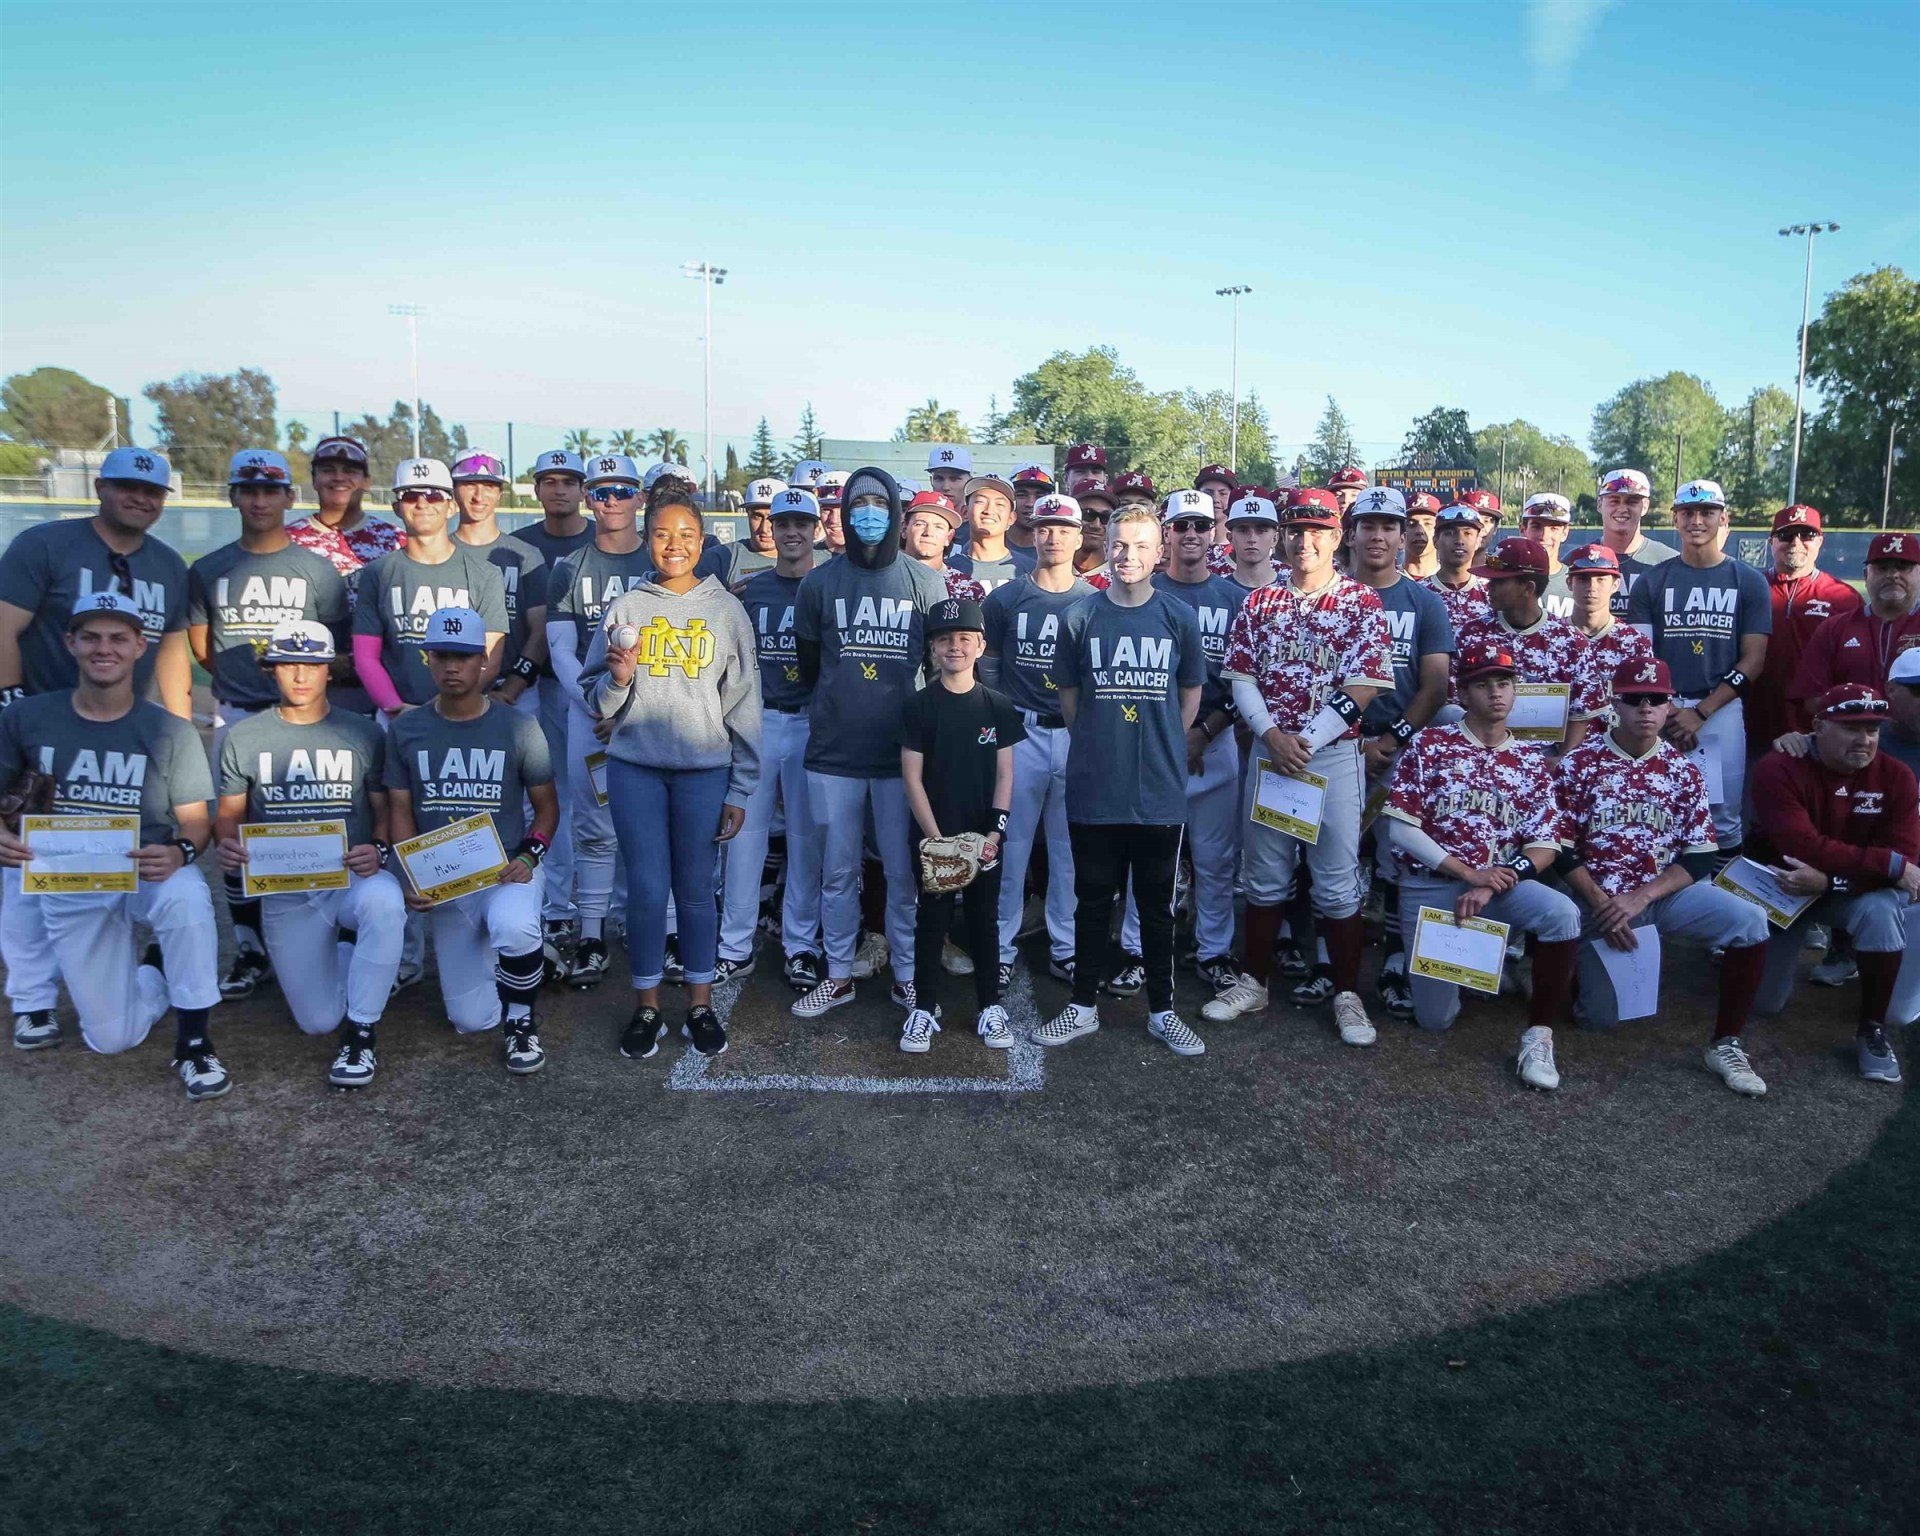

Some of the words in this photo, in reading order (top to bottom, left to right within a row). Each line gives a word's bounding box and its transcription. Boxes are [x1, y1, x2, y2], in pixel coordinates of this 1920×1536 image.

[1407, 470, 1433, 478] DAME
[1435, 470, 1475, 478] KNIGHTS
[217, 578, 229, 606] I
[240, 576, 307, 608] AM
[391, 586, 404, 615] I
[410, 585, 470, 615] AM
[582, 577, 593, 604] I
[602, 576, 641, 602] A
[1664, 588, 1674, 612] I
[1684, 587, 1738, 613] AM
[220, 607, 241, 622] VS.
[243, 606, 303, 623] CANCER
[835, 598, 848, 629] I
[853, 596, 913, 630] AM
[1547, 595, 1575, 619] M
[759, 607, 769, 634] I
[778, 606, 795, 632] A
[1017, 613, 1028, 639] I
[1038, 614, 1059, 641] A
[1199, 606, 1228, 635] M
[1387, 611, 1416, 639] M
[1664, 614, 1684, 627] VS.
[1686, 613, 1733, 628] CANCER
[760, 635, 777, 649] VS.
[855, 629, 909, 647] CANCER
[1017, 641, 1036, 656] VS.
[1202, 636, 1224, 651] CER
[1090, 637, 1102, 668] I
[1112, 636, 1172, 669] AM
[1115, 670, 1169, 688] CANCER
[66, 748, 147, 787] AM
[259, 752, 273, 784] I
[285, 749, 353, 782] AM
[418, 750, 431, 781] I
[439, 748, 506, 781] AM
[54, 784, 65, 799] S.
[68, 785, 141, 805] CANCER
[262, 786, 286, 801] VS.
[290, 784, 353, 801] CANCER
[423, 783, 439, 798] S.
[443, 782, 502, 799] CANCER
[406, 842, 421, 852] AM
[421, 824, 468, 847] #VSCANCER
[1486, 924, 1504, 934] FOR:
[1440, 964, 1462, 974] CANCER
